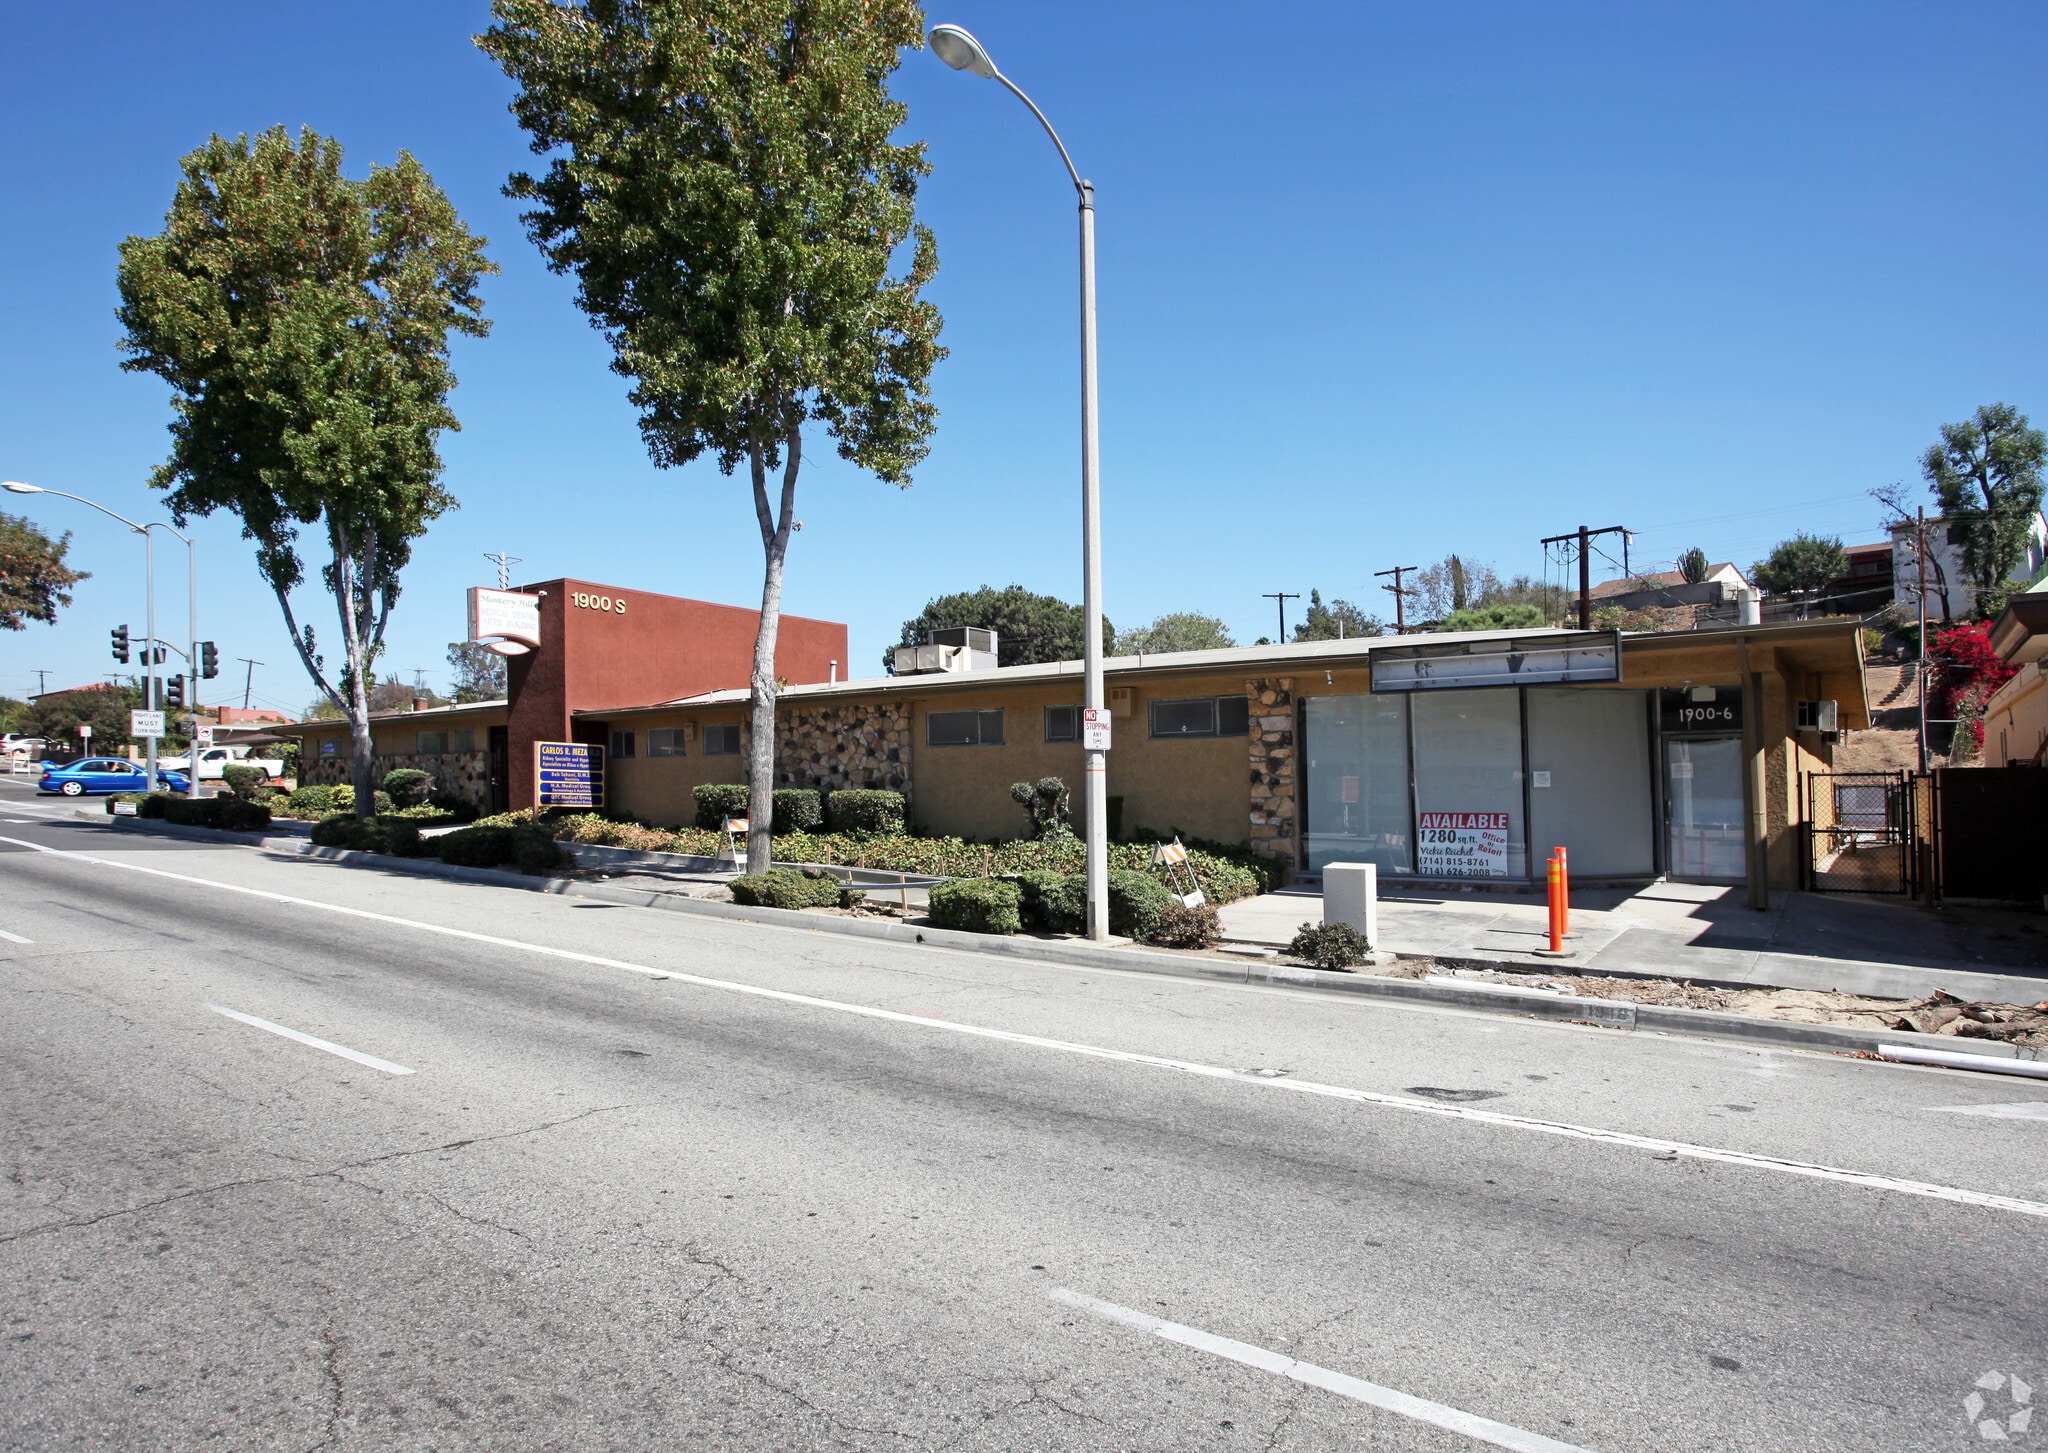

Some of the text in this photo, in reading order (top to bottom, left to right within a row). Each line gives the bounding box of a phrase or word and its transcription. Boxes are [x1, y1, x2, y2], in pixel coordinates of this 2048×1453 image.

[571, 591, 626, 614] 1900 S
[481, 608, 537, 621] MEDICAL DENTAL
[483, 618, 536, 631] ARTS BUILDING
[1086, 711, 1096, 720] NO
[1679, 707, 1733, 722] 1900-6
[1086, 722, 1110, 730] STOPPING
[542, 746, 564, 755] CARLOS
[572, 748, 588, 756] MEZA
[1421, 813, 1507, 829] AVAILABLE
[1420, 829, 1457, 843] 1280
[1481, 831, 1506, 844] Office
[1420, 846, 1474, 856] Vickie Reichel
[1478, 844, 1502, 857] Retail
[1419, 857, 1489, 866] (714) 815-8761
[1419, 866, 1444, 876] (714)
[1446, 868, 1490, 877] 626-2008
